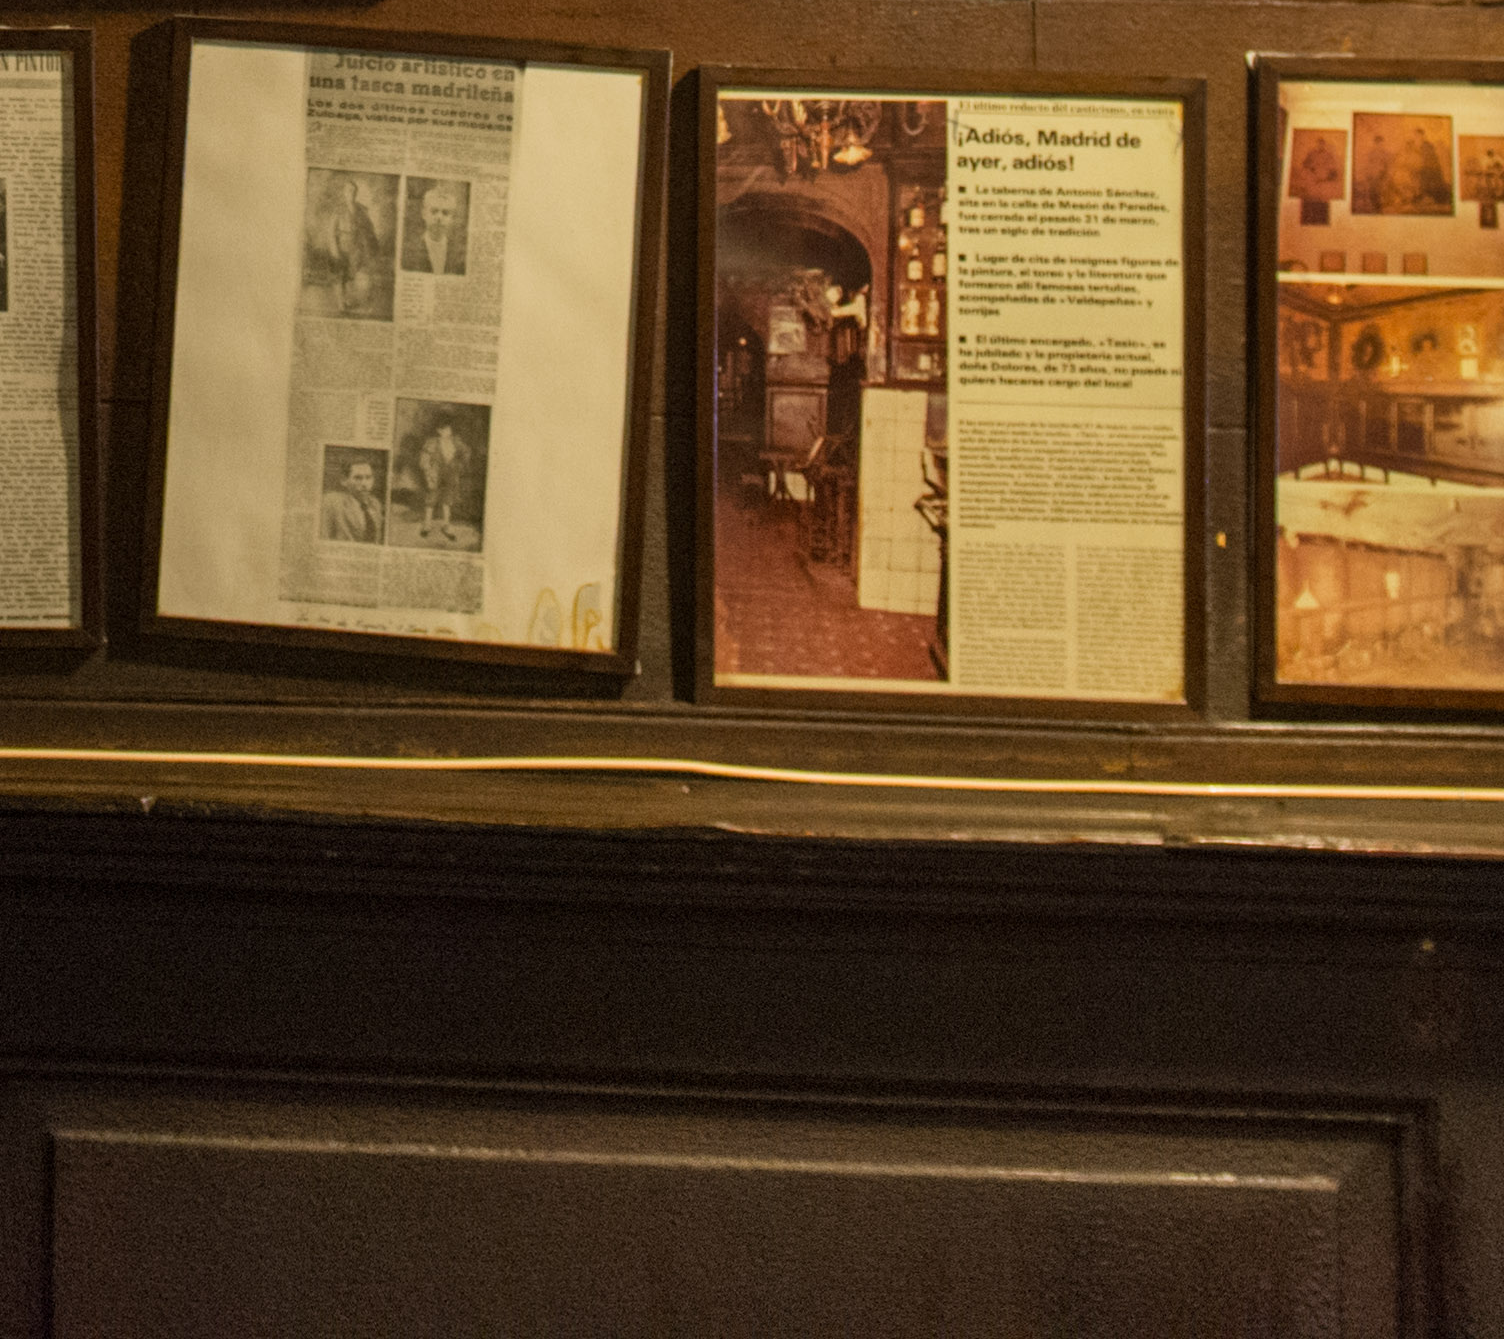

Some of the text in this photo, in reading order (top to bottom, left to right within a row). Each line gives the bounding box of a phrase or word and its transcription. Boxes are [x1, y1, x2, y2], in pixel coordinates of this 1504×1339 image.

[335, 54, 396, 72] Juicio
[492, 69, 516, 81] en
[309, 75, 515, 103] una tasca madrileña
[307, 98, 333, 109] Los
[339, 102, 365, 110] dos
[432, 107, 490, 120] cuadros
[497, 113, 514, 122] de
[366, 114, 405, 124] vistos
[958, 128, 1142, 150] ¡Adiós, Madrid de
[957, 155, 1075, 173] ayer, adiós!
[975, 186, 1159, 202] La taberna de Antonio Sánchez,
[958, 198, 1170, 215] sita en la calle de Mesón de Paredes,
[980, 212, 1025, 223] cerrada
[1038, 213, 1082, 227] pasado
[1118, 217, 1159, 228] marzo,
[959, 225, 982, 235] tras
[1000, 226, 1030, 239] siglo
[1048, 227, 1101, 237] tradición
[975, 254, 1010, 267] Lugar
[1027, 255, 1051, 265] cita
[1069, 255, 1119, 269] insignes
[1121, 256, 1163, 269] figuras
[970, 266, 1018, 280] pintura,
[1031, 267, 1065, 278] toreo
[1088, 269, 1143, 280] literatura
[958, 279, 1014, 291] formaron
[1034, 281, 1086, 292] famosas
[1087, 282, 1140, 296] tertulias,
[959, 293, 1042, 307] acompañadas
[959, 306, 1001, 319] torrijas
[988, 335, 1028, 346] último
[1030, 336, 1095, 350] encargado,
[974, 348, 1023, 362] jubilado
[1046, 350, 1114, 364] propietaria
[1114, 351, 1155, 365] actual,
[960, 362, 988, 372] doña
[991, 363, 1039, 376] Dolores,
[1080, 364, 1110, 377] años,
[1131, 365, 1167, 379] puede
[959, 375, 998, 388] quiere
[997, 376, 1047, 387] hacerse
[1047, 379, 1082, 390] cargo
[1103, 378, 1134, 389] local
